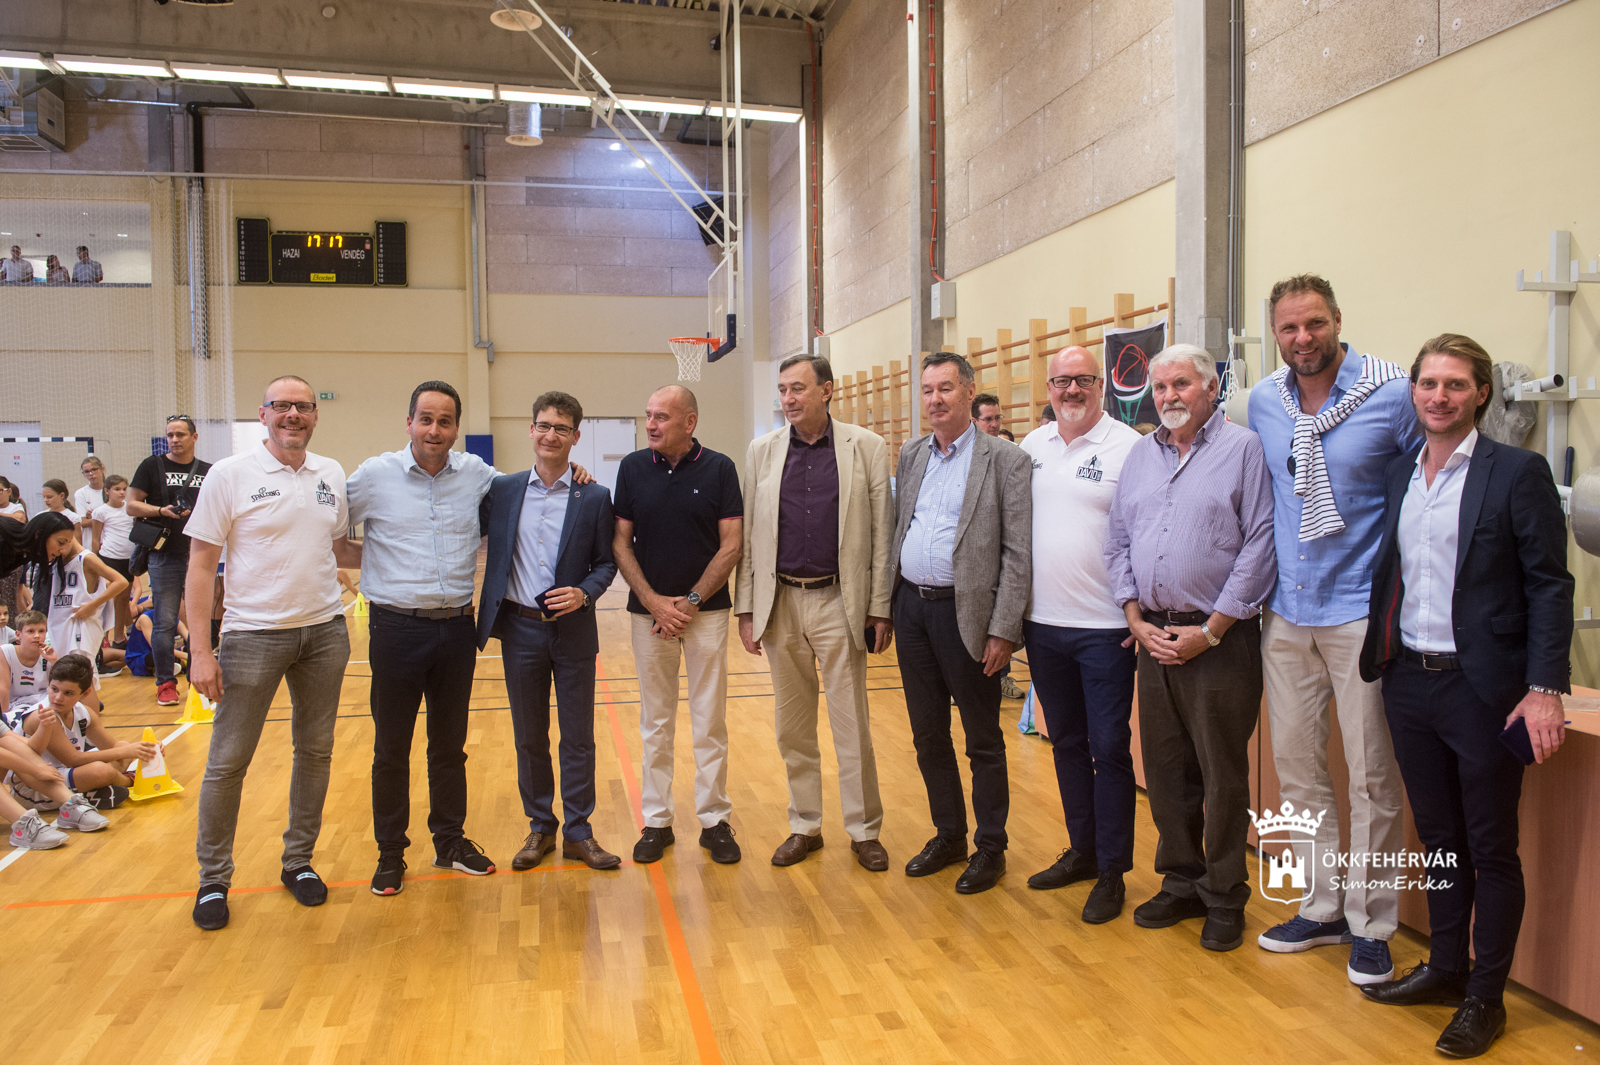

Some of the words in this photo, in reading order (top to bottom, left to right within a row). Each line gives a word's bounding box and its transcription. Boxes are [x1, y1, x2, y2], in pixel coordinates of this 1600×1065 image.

[282, 249, 300, 258] HAZAI
[340, 249, 365, 259] VENDÉG
[312, 274, 335, 282] Bodet
[251, 489, 280, 502] SPALDING
